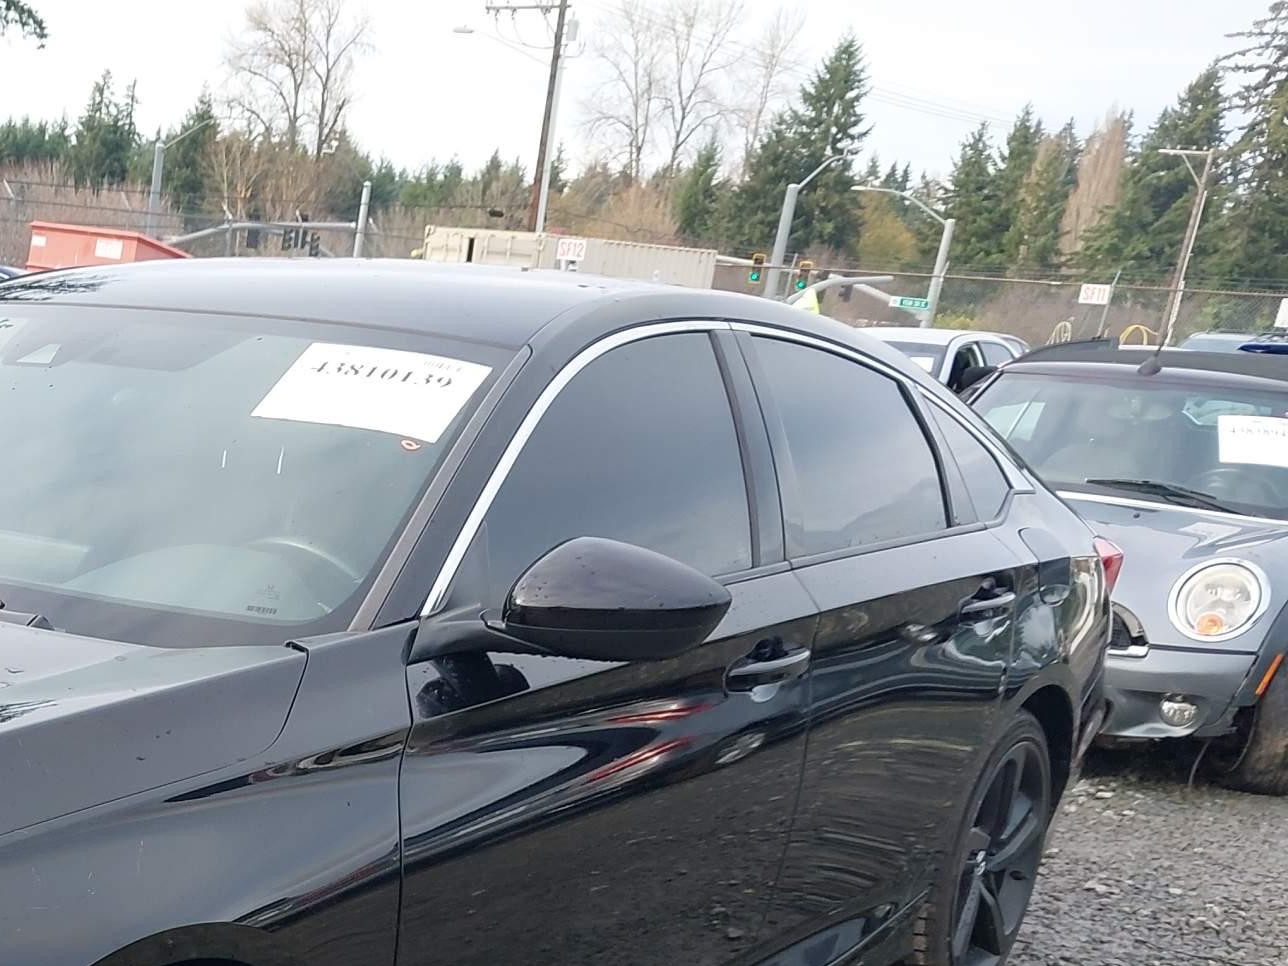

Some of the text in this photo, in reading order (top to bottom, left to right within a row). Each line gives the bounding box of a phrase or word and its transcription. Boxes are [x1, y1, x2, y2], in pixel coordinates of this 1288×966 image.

[559, 241, 584, 258] SF12
[1082, 285, 1106, 302] SF11
[310, 360, 453, 389] 43810139
